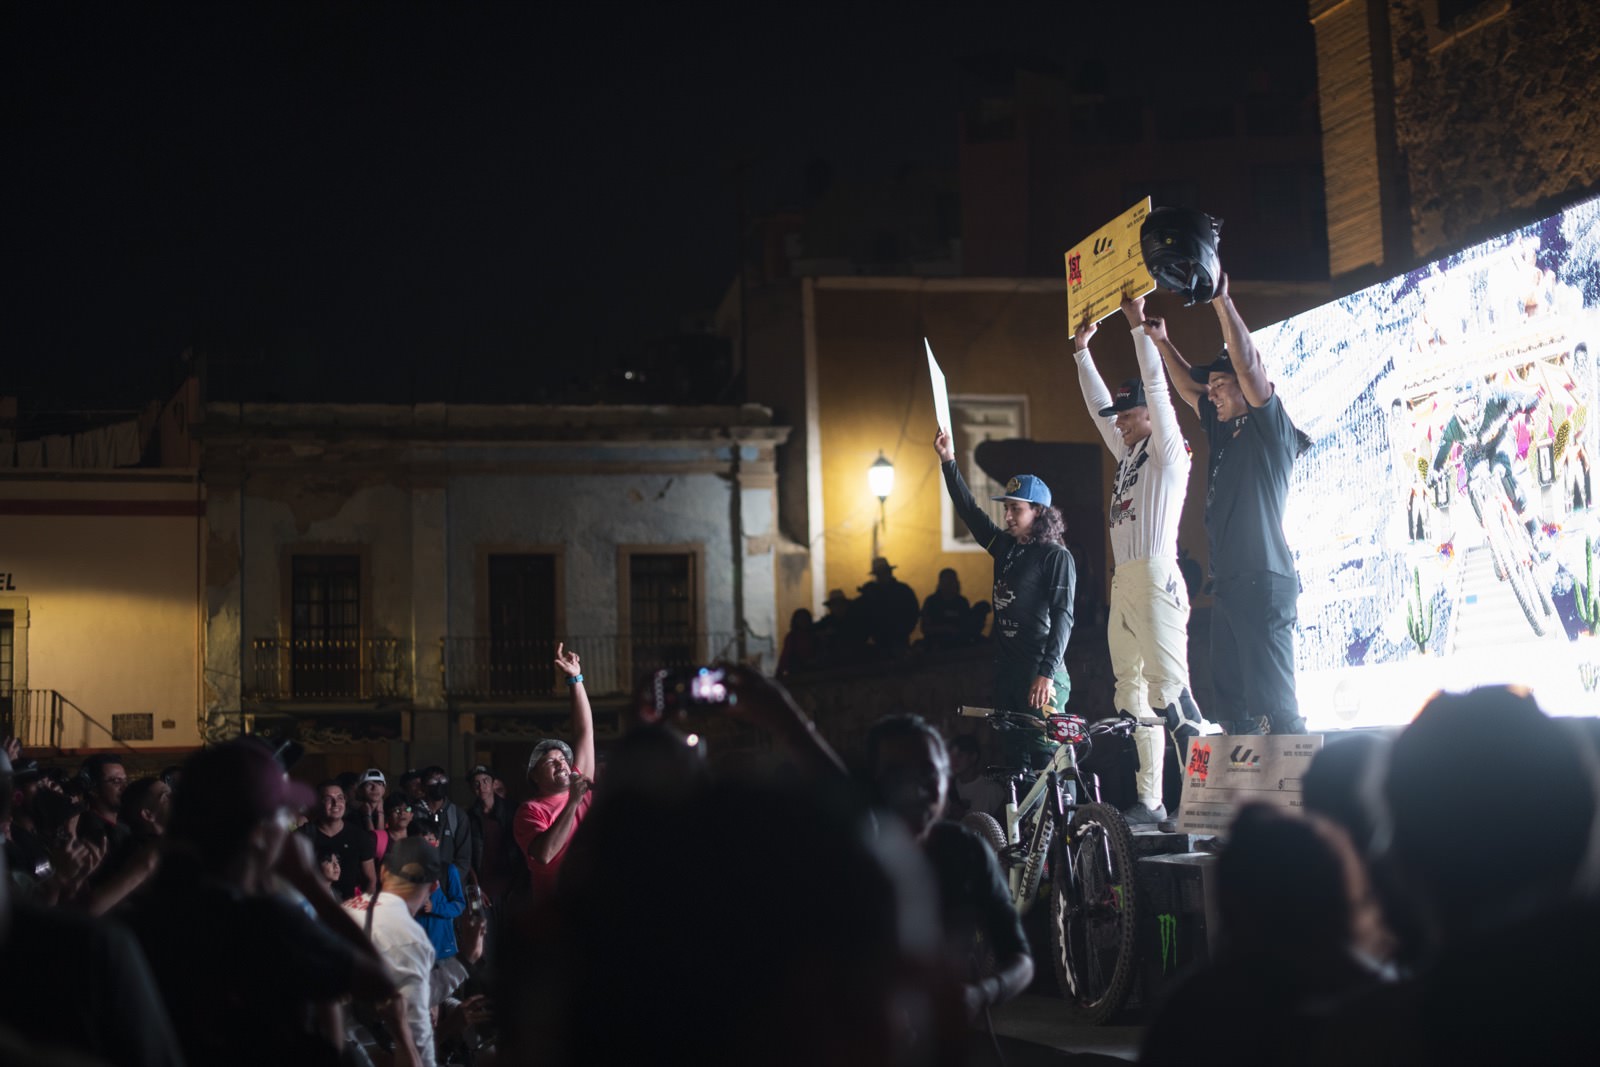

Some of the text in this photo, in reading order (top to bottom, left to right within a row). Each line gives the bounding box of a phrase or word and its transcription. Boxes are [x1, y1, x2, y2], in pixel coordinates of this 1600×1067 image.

[1069, 254, 1081, 272] 1ST
[1191, 748, 1210, 765] 2ND
[1189, 761, 1209, 776] PLACE
